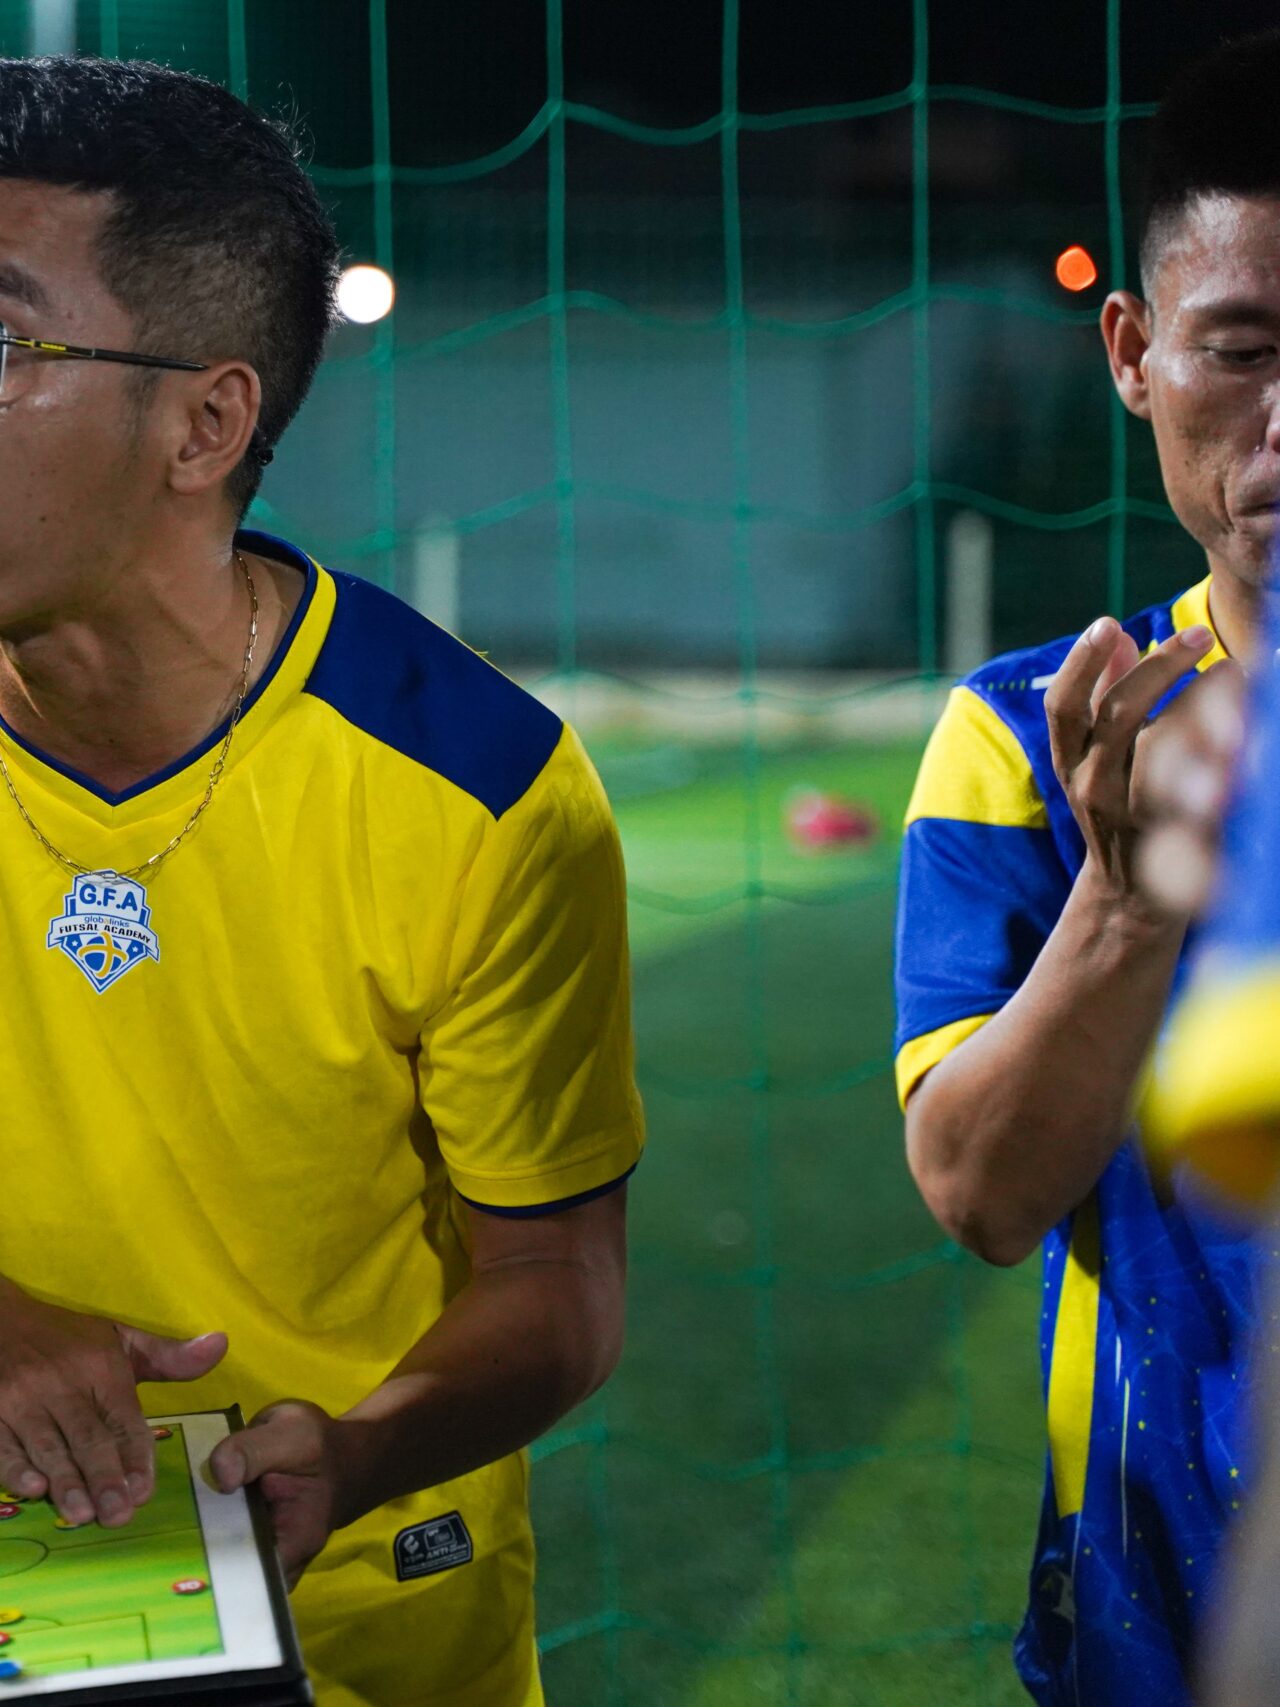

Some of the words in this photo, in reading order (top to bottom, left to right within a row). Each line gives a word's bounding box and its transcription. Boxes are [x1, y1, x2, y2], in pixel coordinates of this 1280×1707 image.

[79, 883, 138, 911] G.F.A
[59, 923, 99, 934] FUTSAL
[103, 924, 151, 944] ACADEMY
